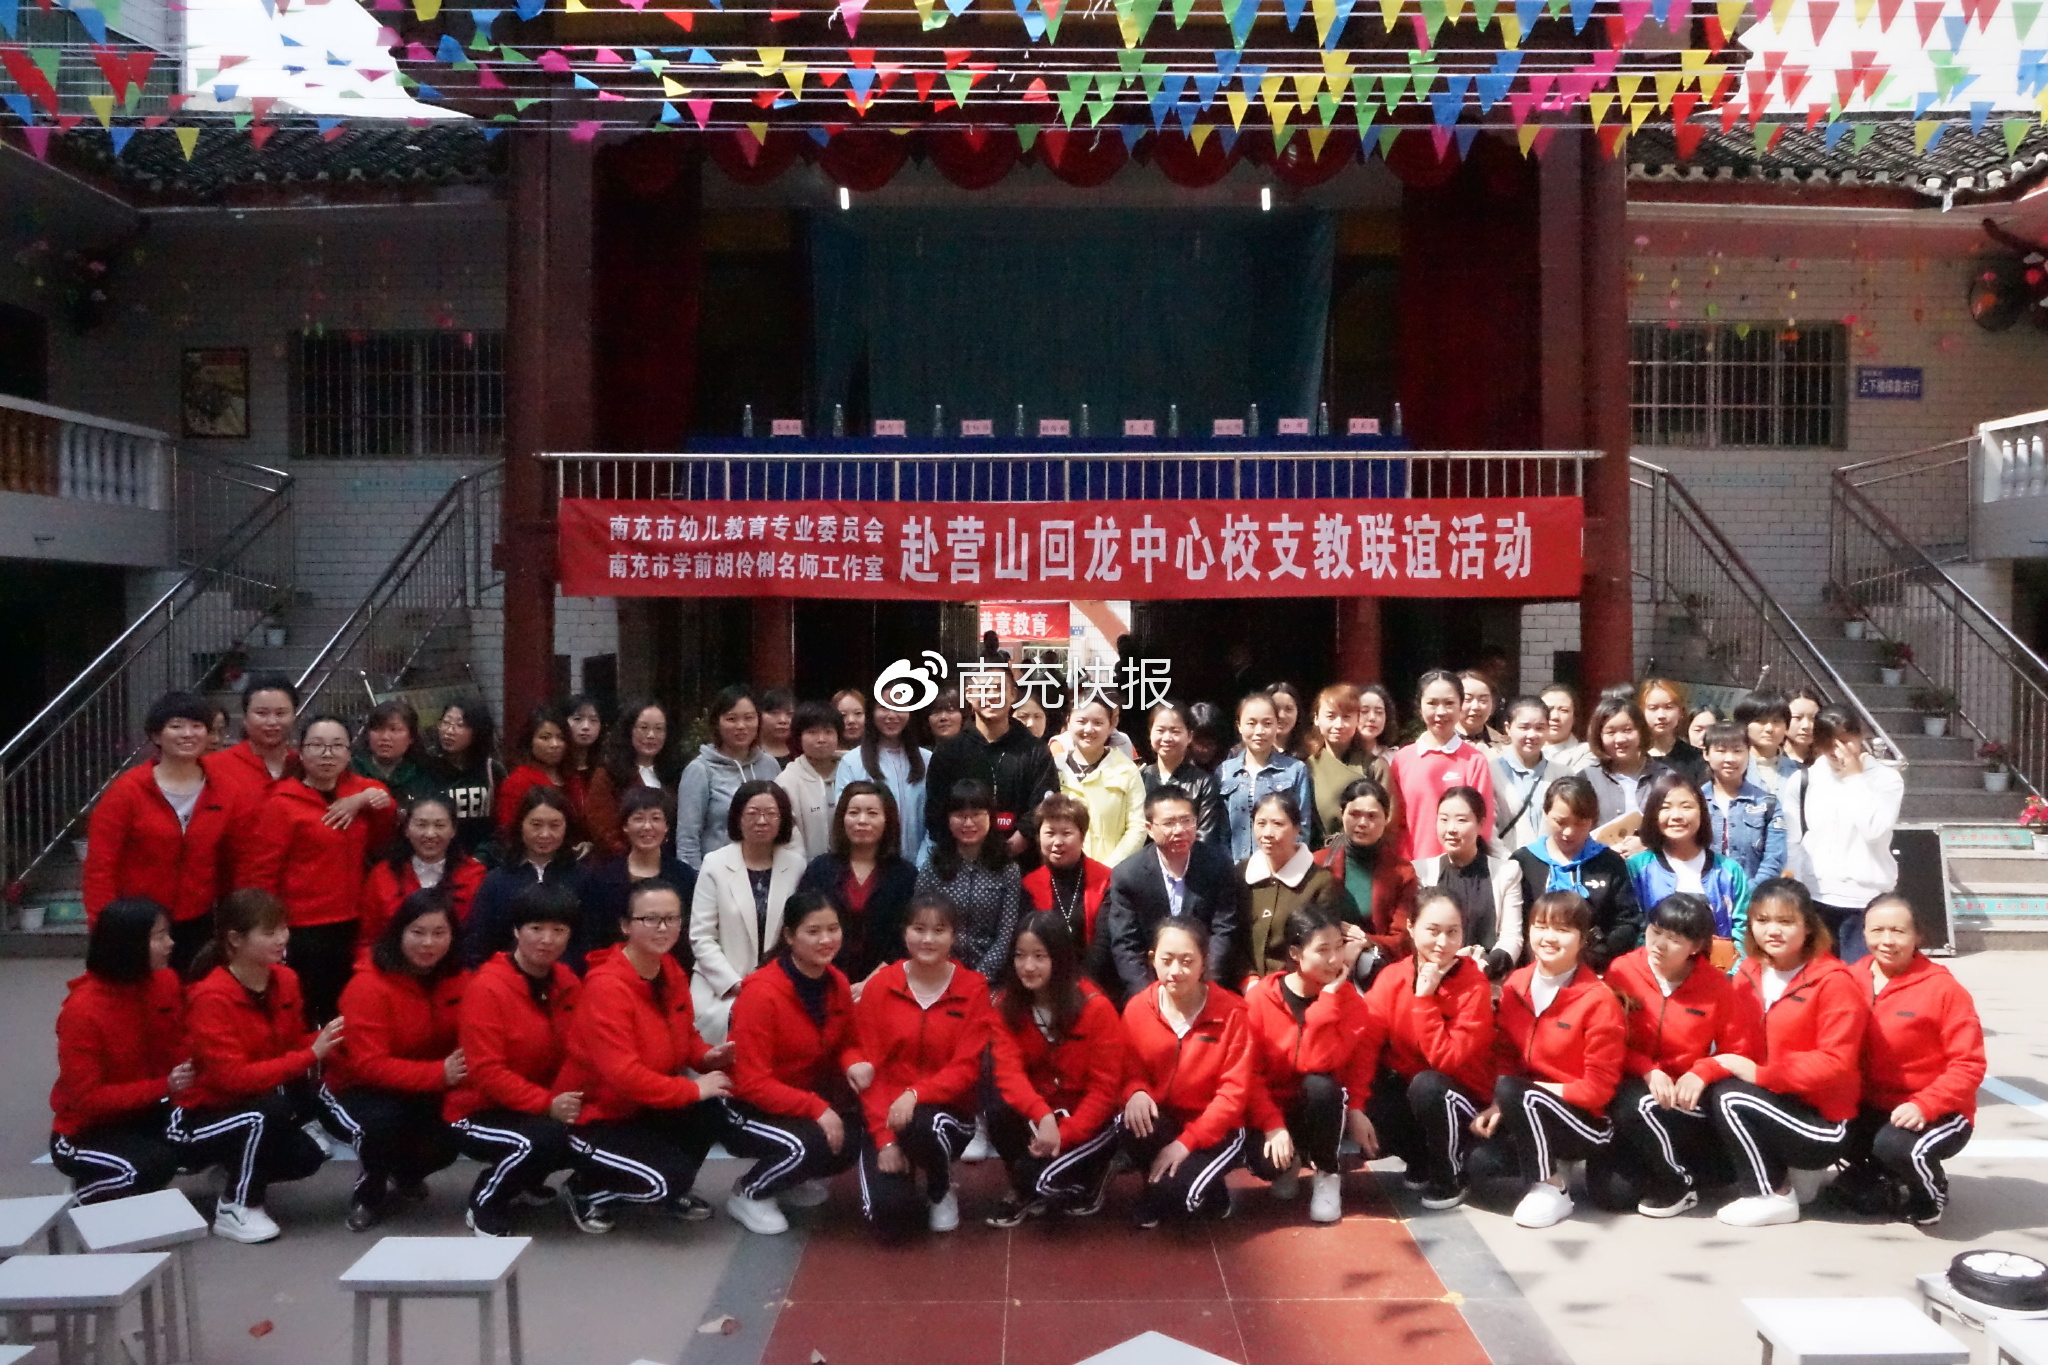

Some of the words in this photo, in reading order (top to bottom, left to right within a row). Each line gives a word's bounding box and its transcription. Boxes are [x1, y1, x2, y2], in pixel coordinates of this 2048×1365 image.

[609, 514, 884, 543] 南充市幼儿教育专业委员会
[899, 511, 1532, 584] 赴营山回龙中心校支教联谊活动
[609, 551, 884, 581] 南充市学前胡伶俐名师工作室
[980, 611, 1048, 637] 满意教育
